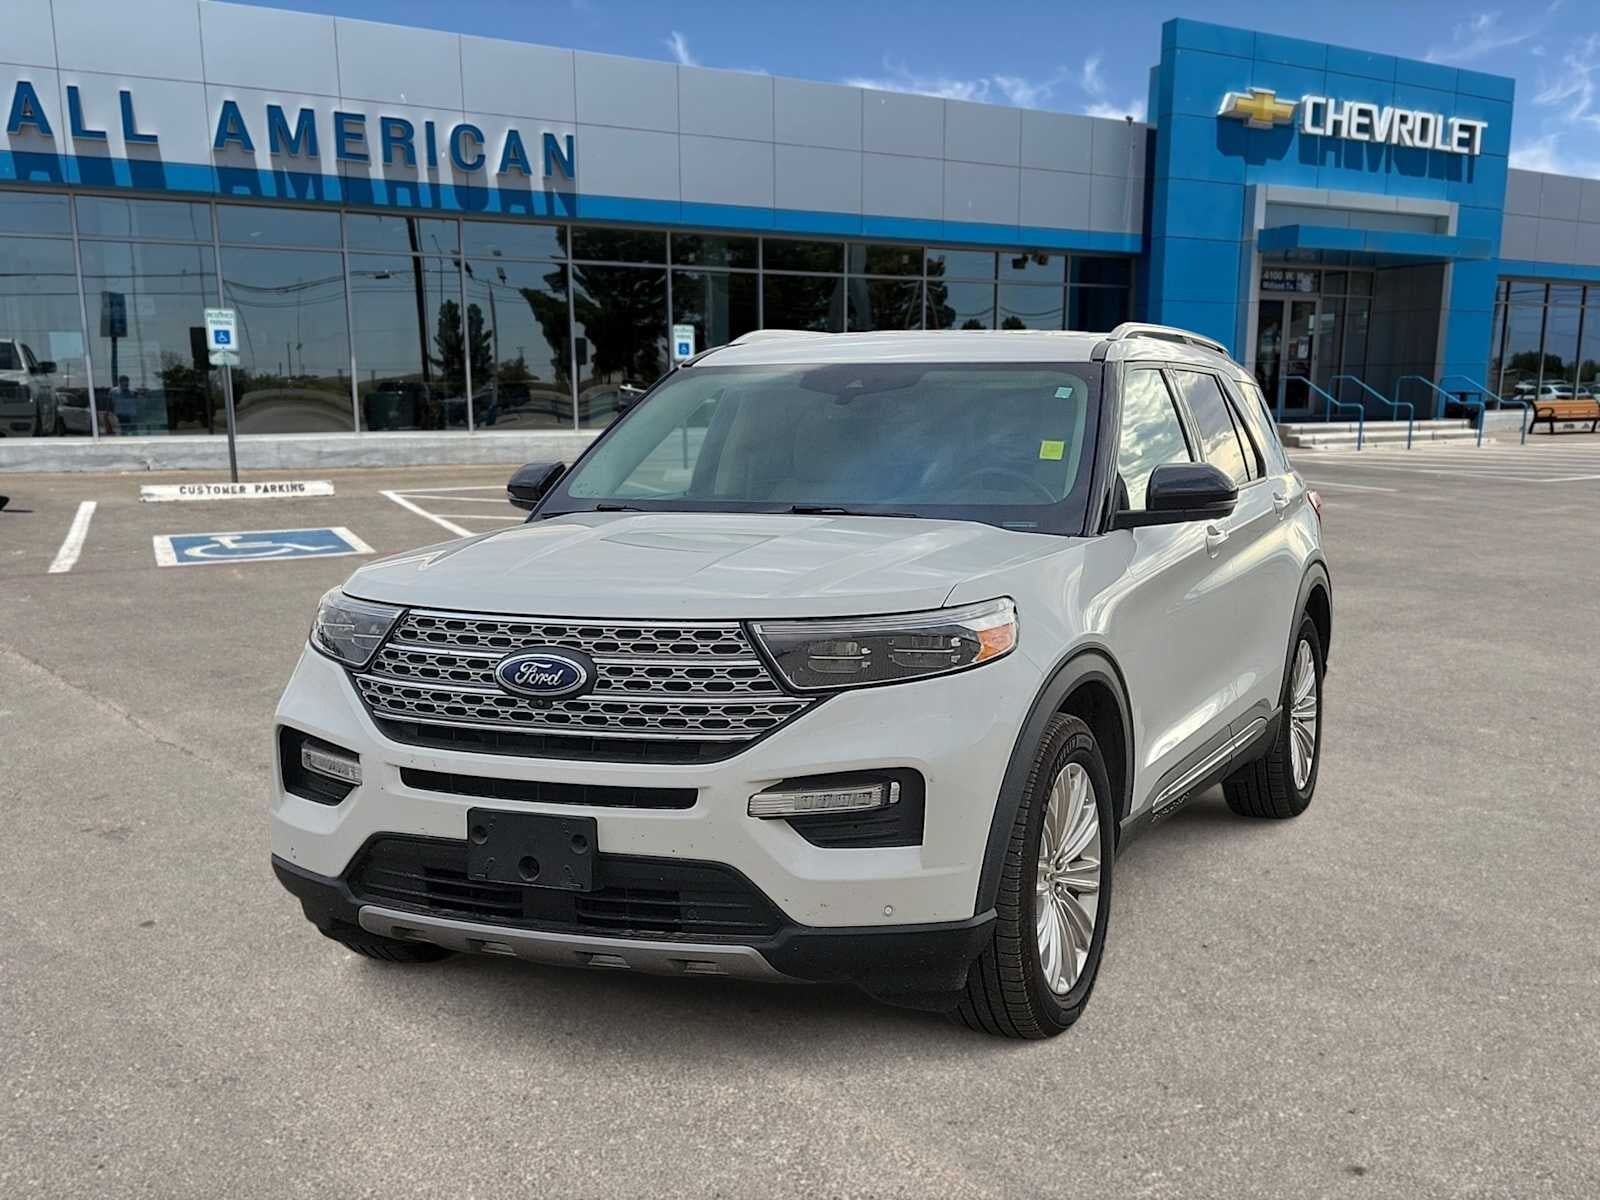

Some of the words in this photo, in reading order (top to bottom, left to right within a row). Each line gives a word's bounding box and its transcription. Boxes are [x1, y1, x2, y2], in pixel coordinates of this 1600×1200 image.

[6, 80, 159, 144] ALL
[213, 100, 576, 178] AMERICAN
[1302, 94, 1488, 156] CHEVROLET
[179, 485, 247, 495] CUSTOMER
[254, 483, 306, 494] PARKING
[514, 661, 564, 686] Ford
